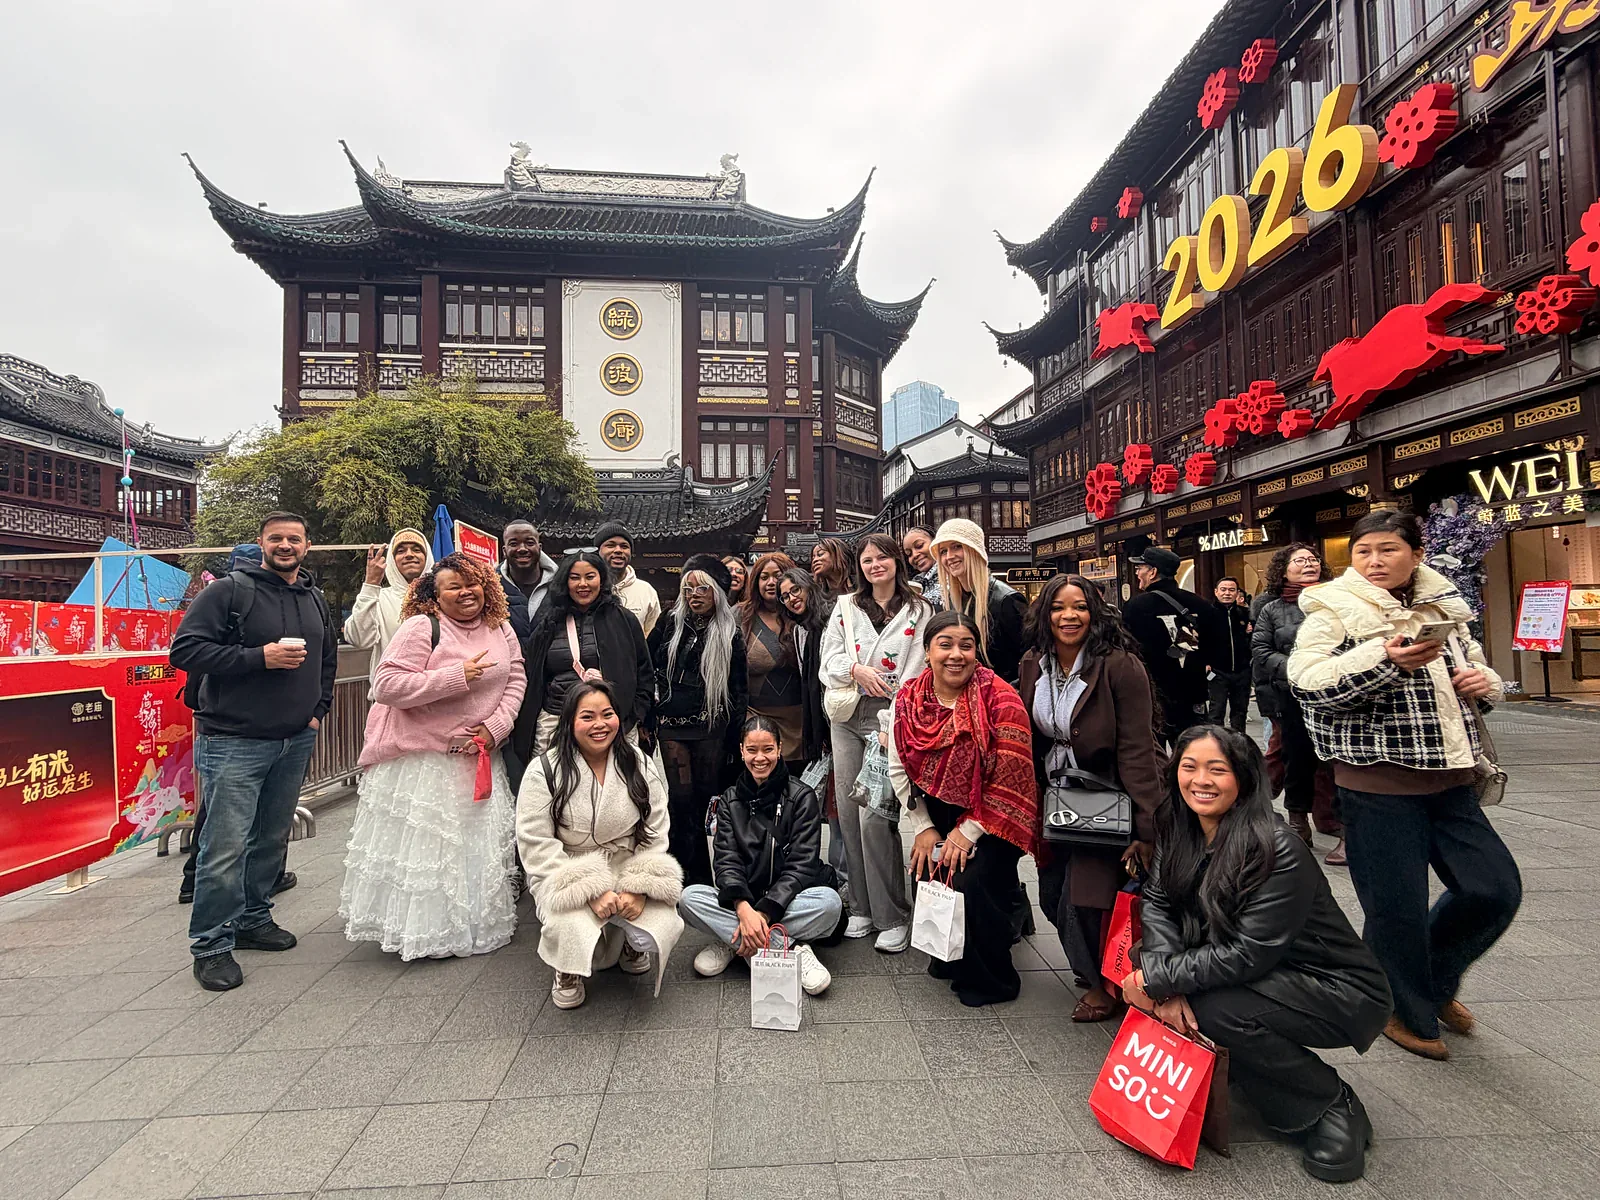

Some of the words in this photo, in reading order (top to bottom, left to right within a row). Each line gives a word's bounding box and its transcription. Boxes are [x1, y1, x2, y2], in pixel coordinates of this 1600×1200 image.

[1160, 83, 1379, 330] 2026
[1468, 451, 1584, 504] WEI
[85, 701, 103, 714] 老庙
[21, 770, 95, 805] 好运发生
[1113, 940, 1127, 975] HORSE
[1123, 1031, 1194, 1092] MINI
